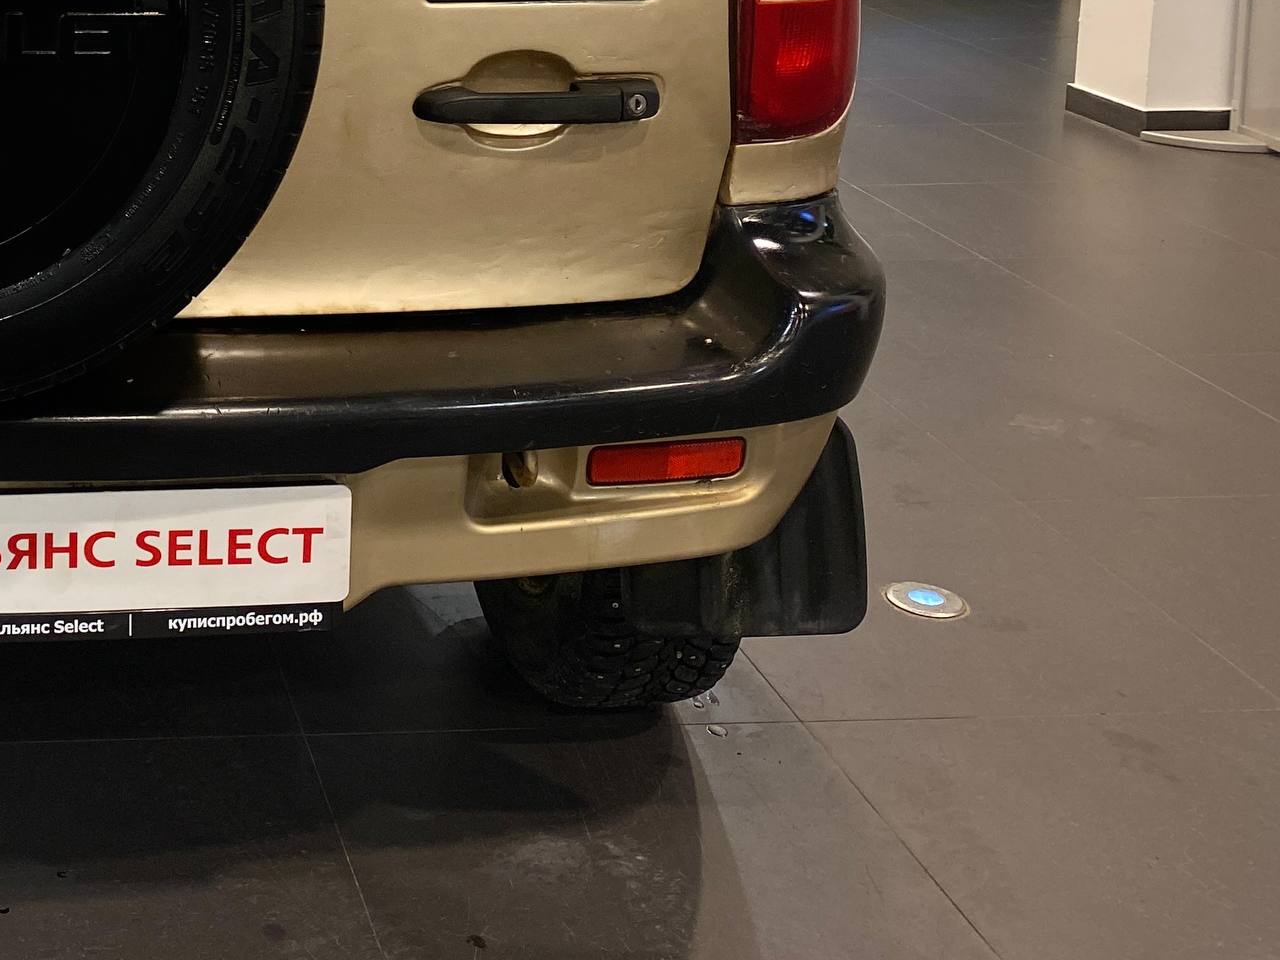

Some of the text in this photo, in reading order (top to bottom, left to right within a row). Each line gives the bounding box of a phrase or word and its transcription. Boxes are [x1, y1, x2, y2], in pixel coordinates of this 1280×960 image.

[135, 527, 324, 567] SELECT
[54, 619, 105, 633] Select
[168, 609, 323, 632] куписпробегом.рф
